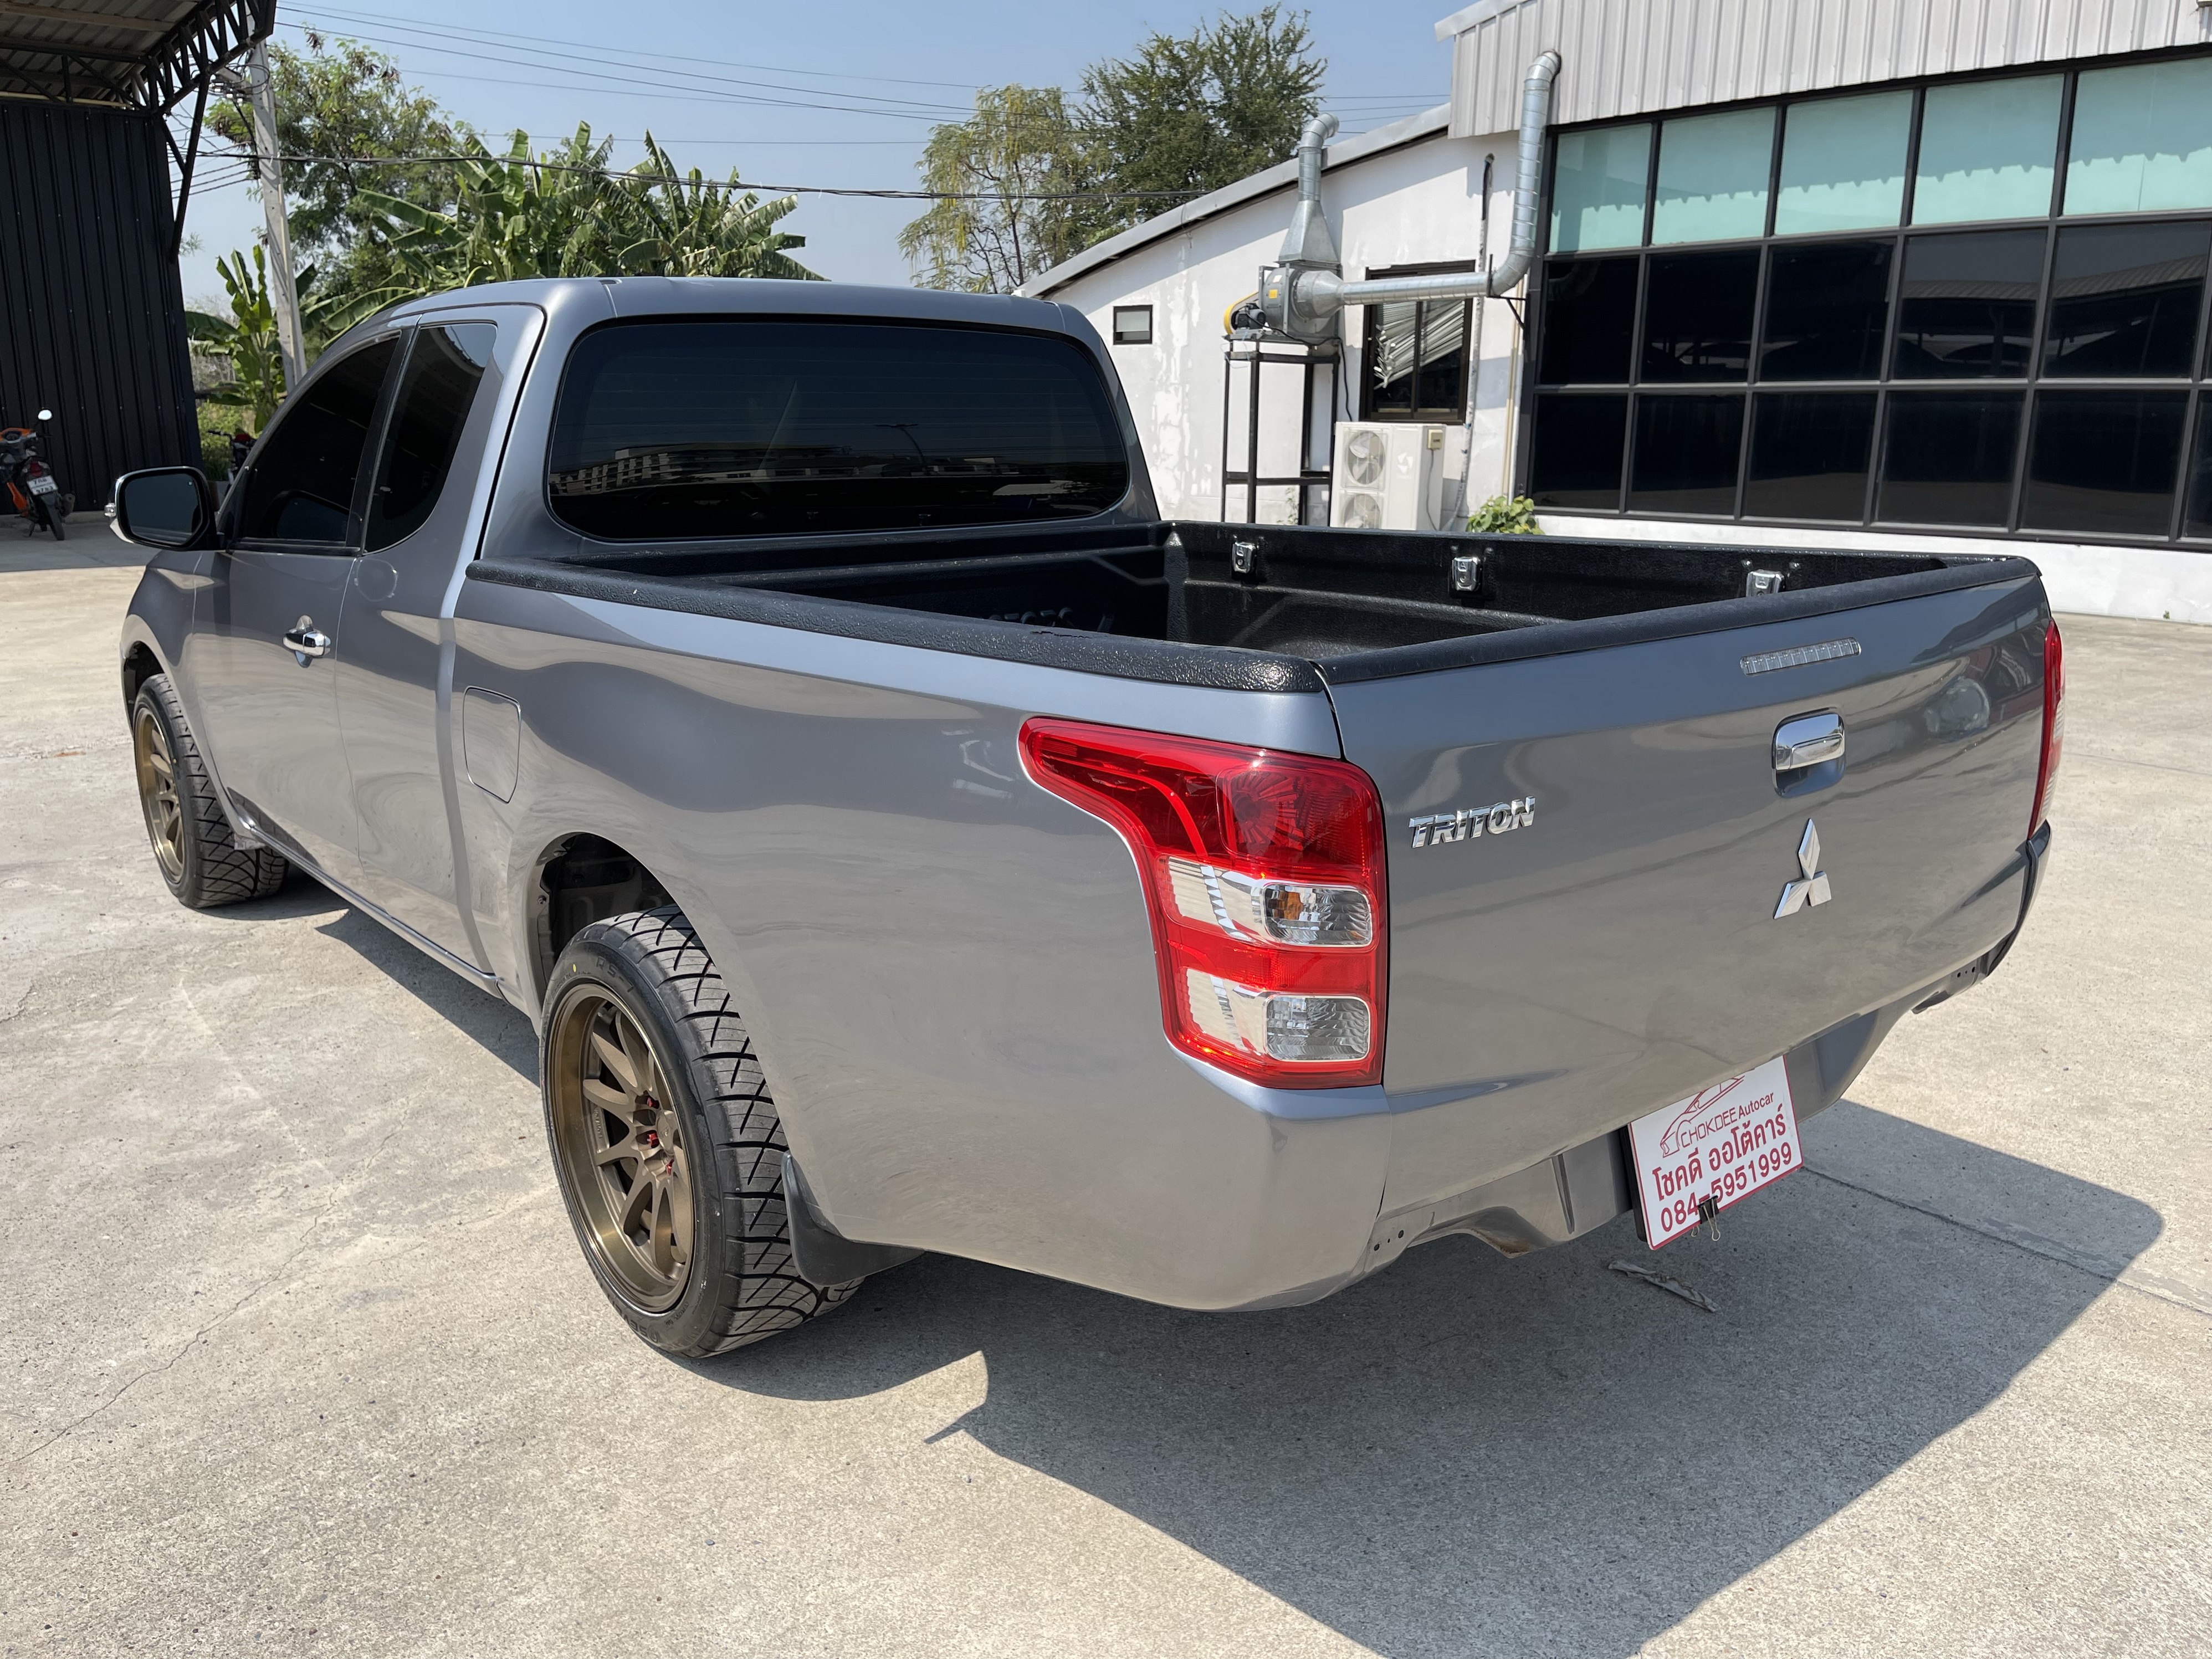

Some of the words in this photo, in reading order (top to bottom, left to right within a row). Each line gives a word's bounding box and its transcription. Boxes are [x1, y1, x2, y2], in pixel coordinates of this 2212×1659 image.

[1409, 796, 1535, 848] TRITON
[1652, 1146, 1703, 1201] โชคดี
[1708, 1103, 1786, 1171] ออโต้คาร์
[1681, 1107, 1737, 1148] CHOKDEE
[1739, 1093, 1773, 1119] Autocar
[1661, 1141, 1792, 1232] 084-5951999
